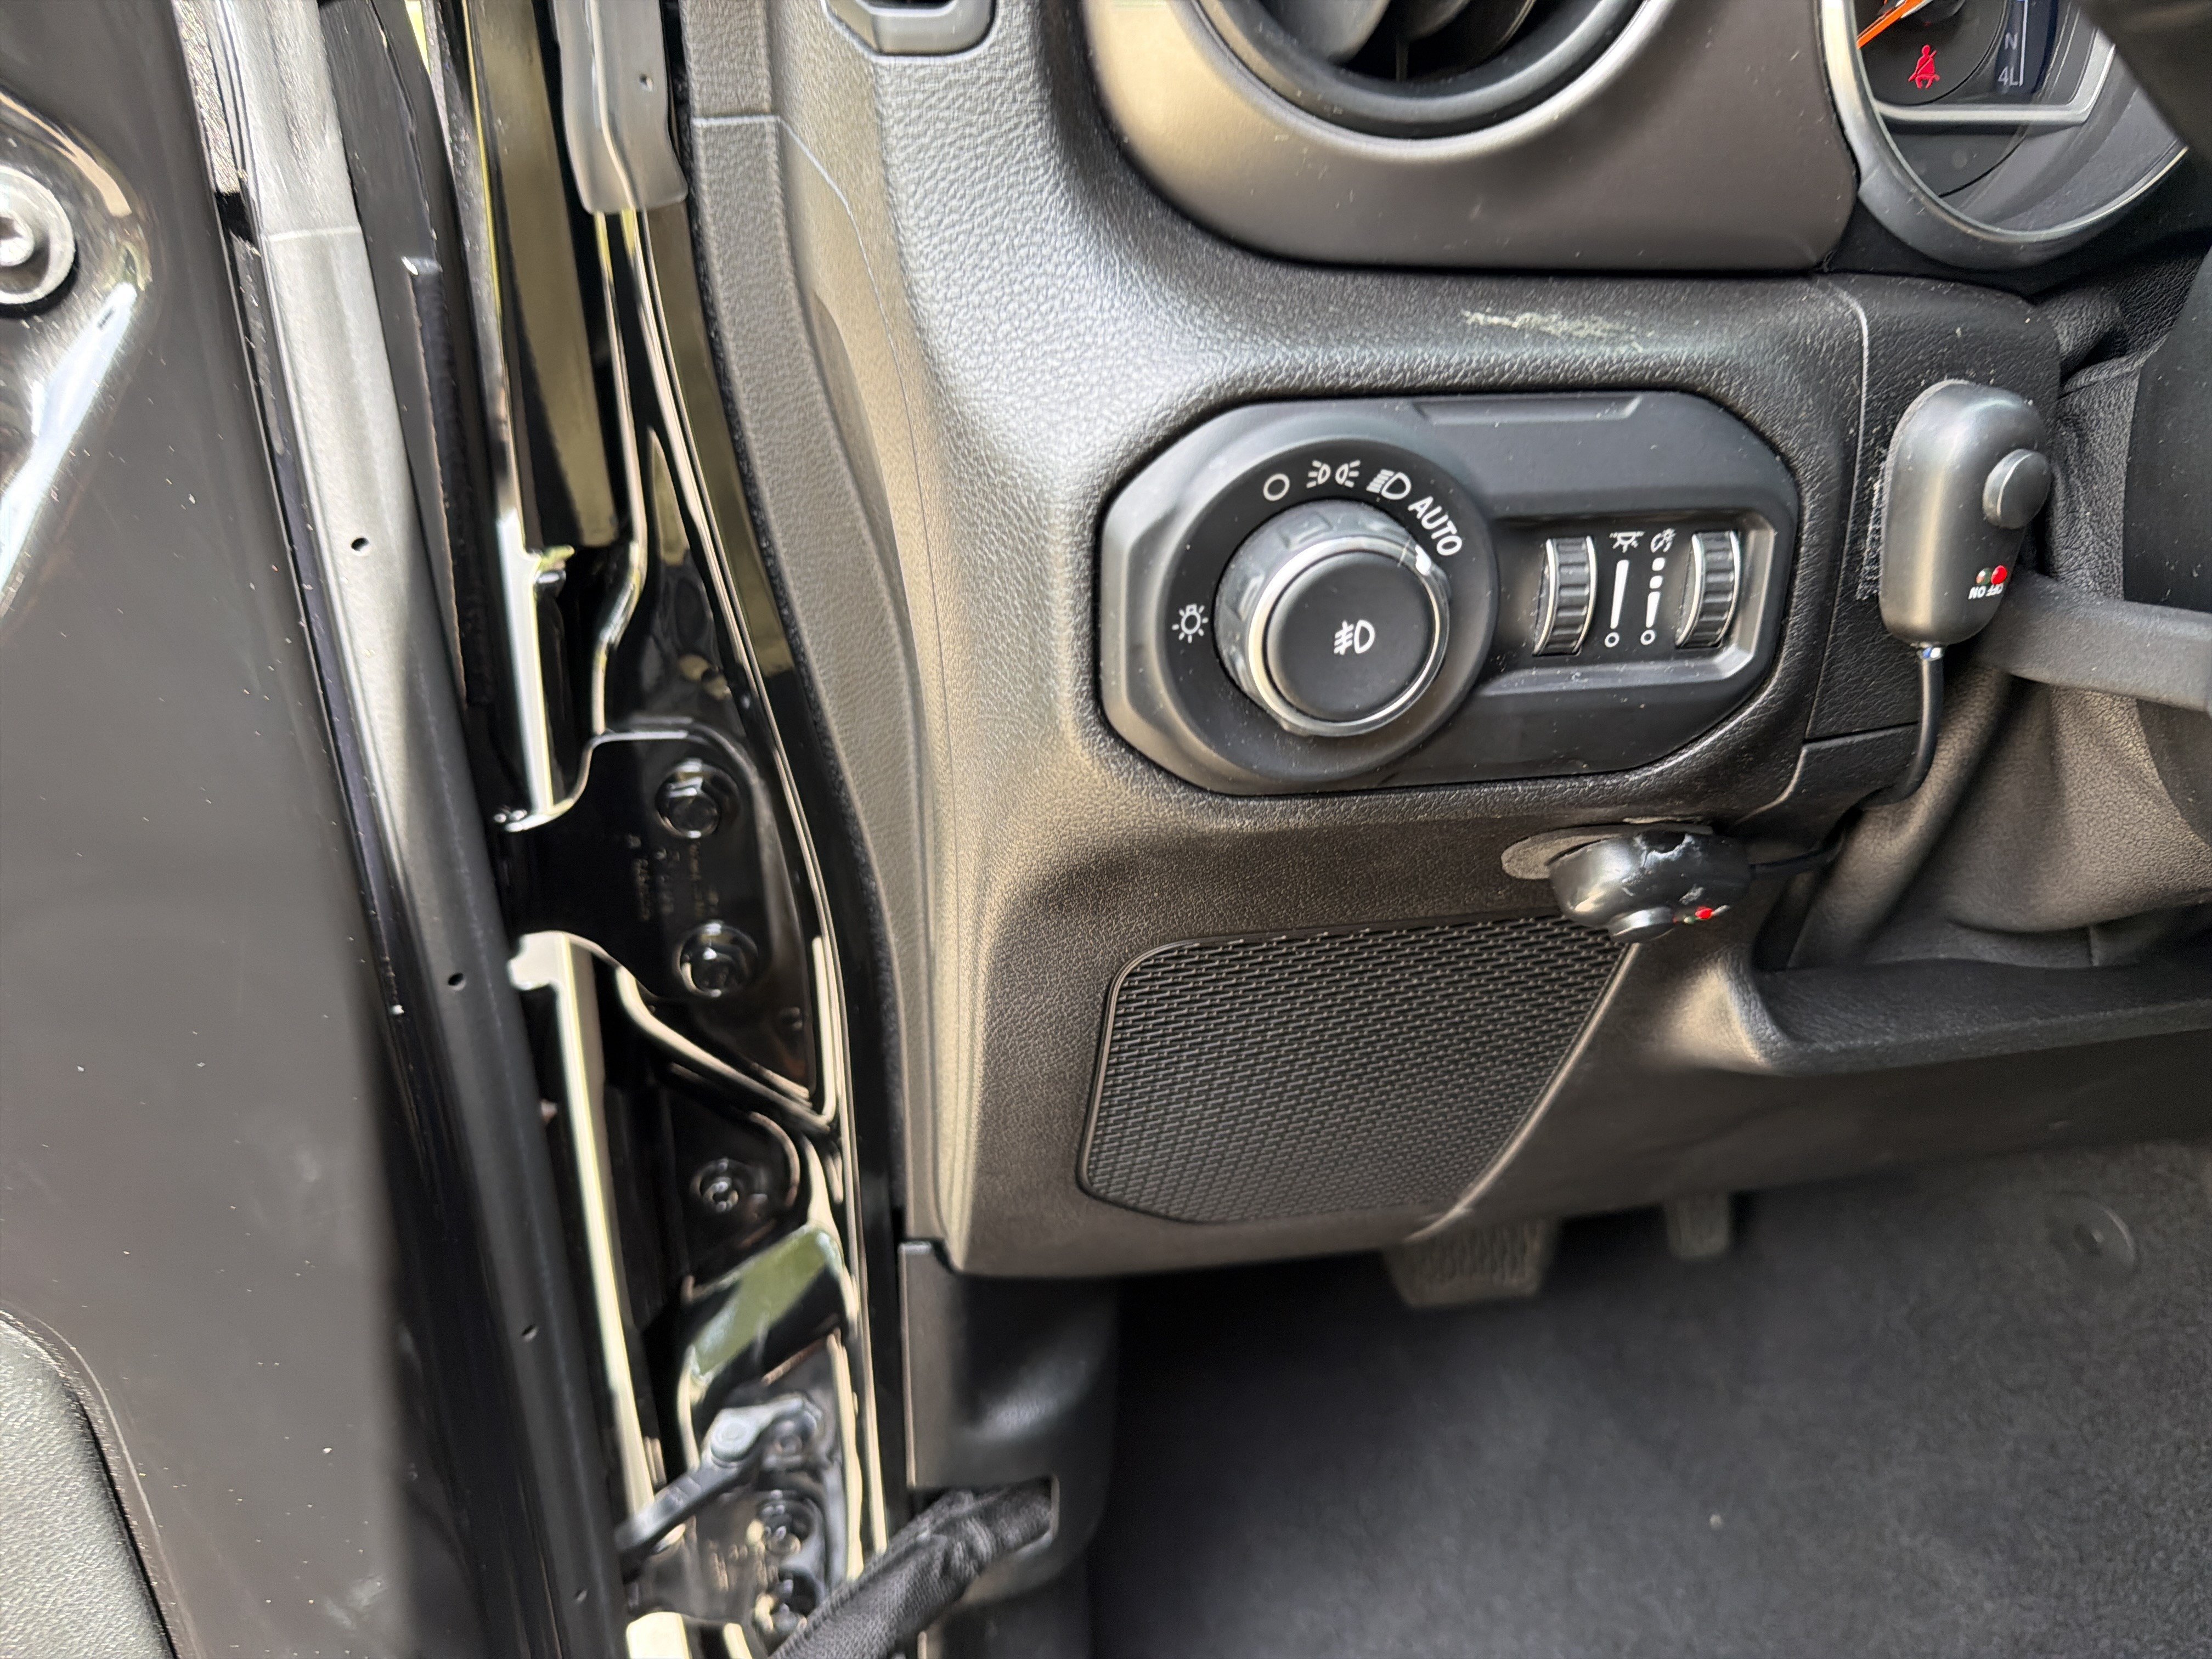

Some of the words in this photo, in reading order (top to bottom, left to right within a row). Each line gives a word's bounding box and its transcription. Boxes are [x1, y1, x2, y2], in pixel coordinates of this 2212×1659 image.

[2004, 32, 2018, 50] N
[1997, 66, 2019, 86] 4L
[1407, 495, 1463, 556] AUTO
[1968, 585, 1987, 600] ON
